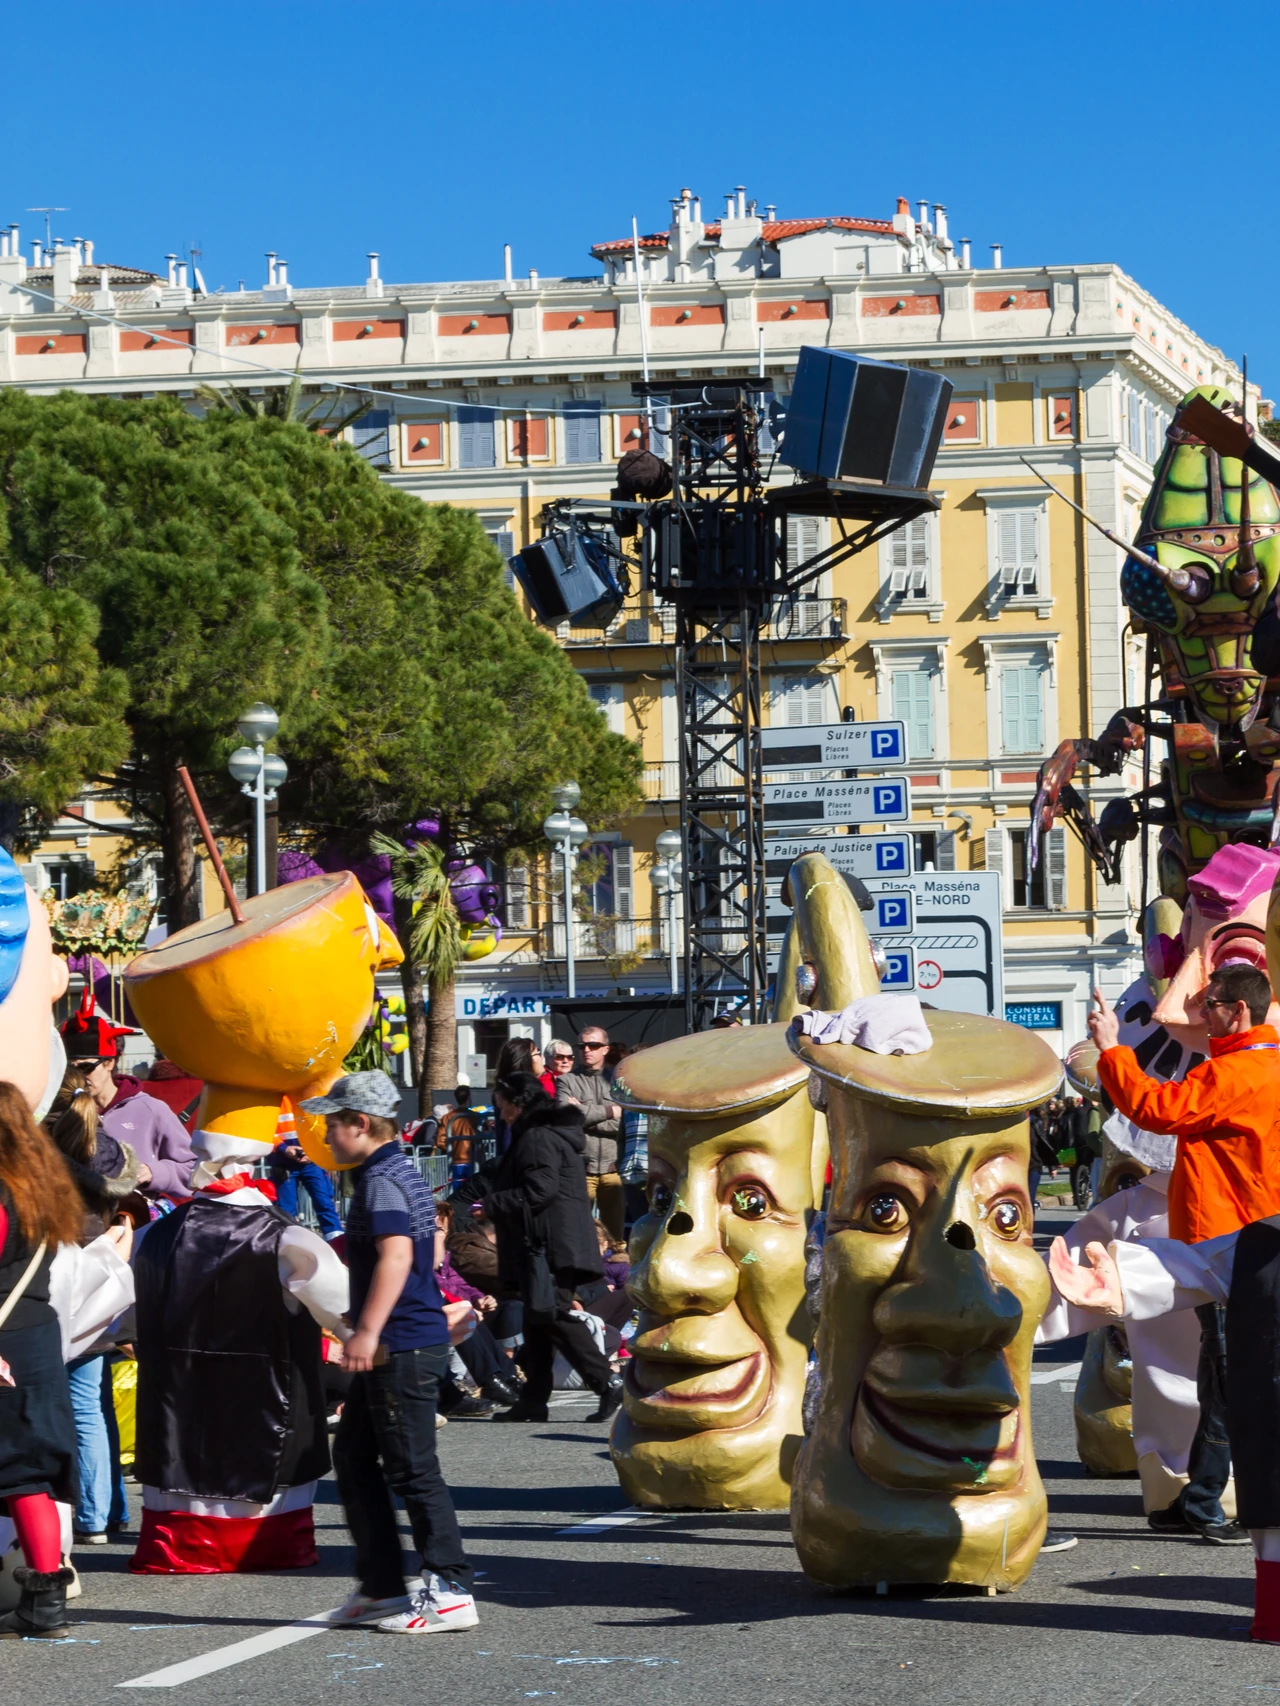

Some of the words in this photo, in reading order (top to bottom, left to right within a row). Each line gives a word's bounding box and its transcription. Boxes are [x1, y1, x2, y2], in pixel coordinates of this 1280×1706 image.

[827, 729, 868, 741] Sulzer
[825, 753, 850, 761] Libres
[773, 788, 808, 800] Place
[815, 785, 870, 798] Masséna
[827, 801, 852, 809] Places
[828, 809, 852, 817] Libres
[774, 844, 808, 856] Palais
[813, 843, 826, 854] de
[831, 841, 873, 853] Justice
[924, 880, 980, 892] Masséna
[1007, 1005, 1052, 1014] CONSEIL
